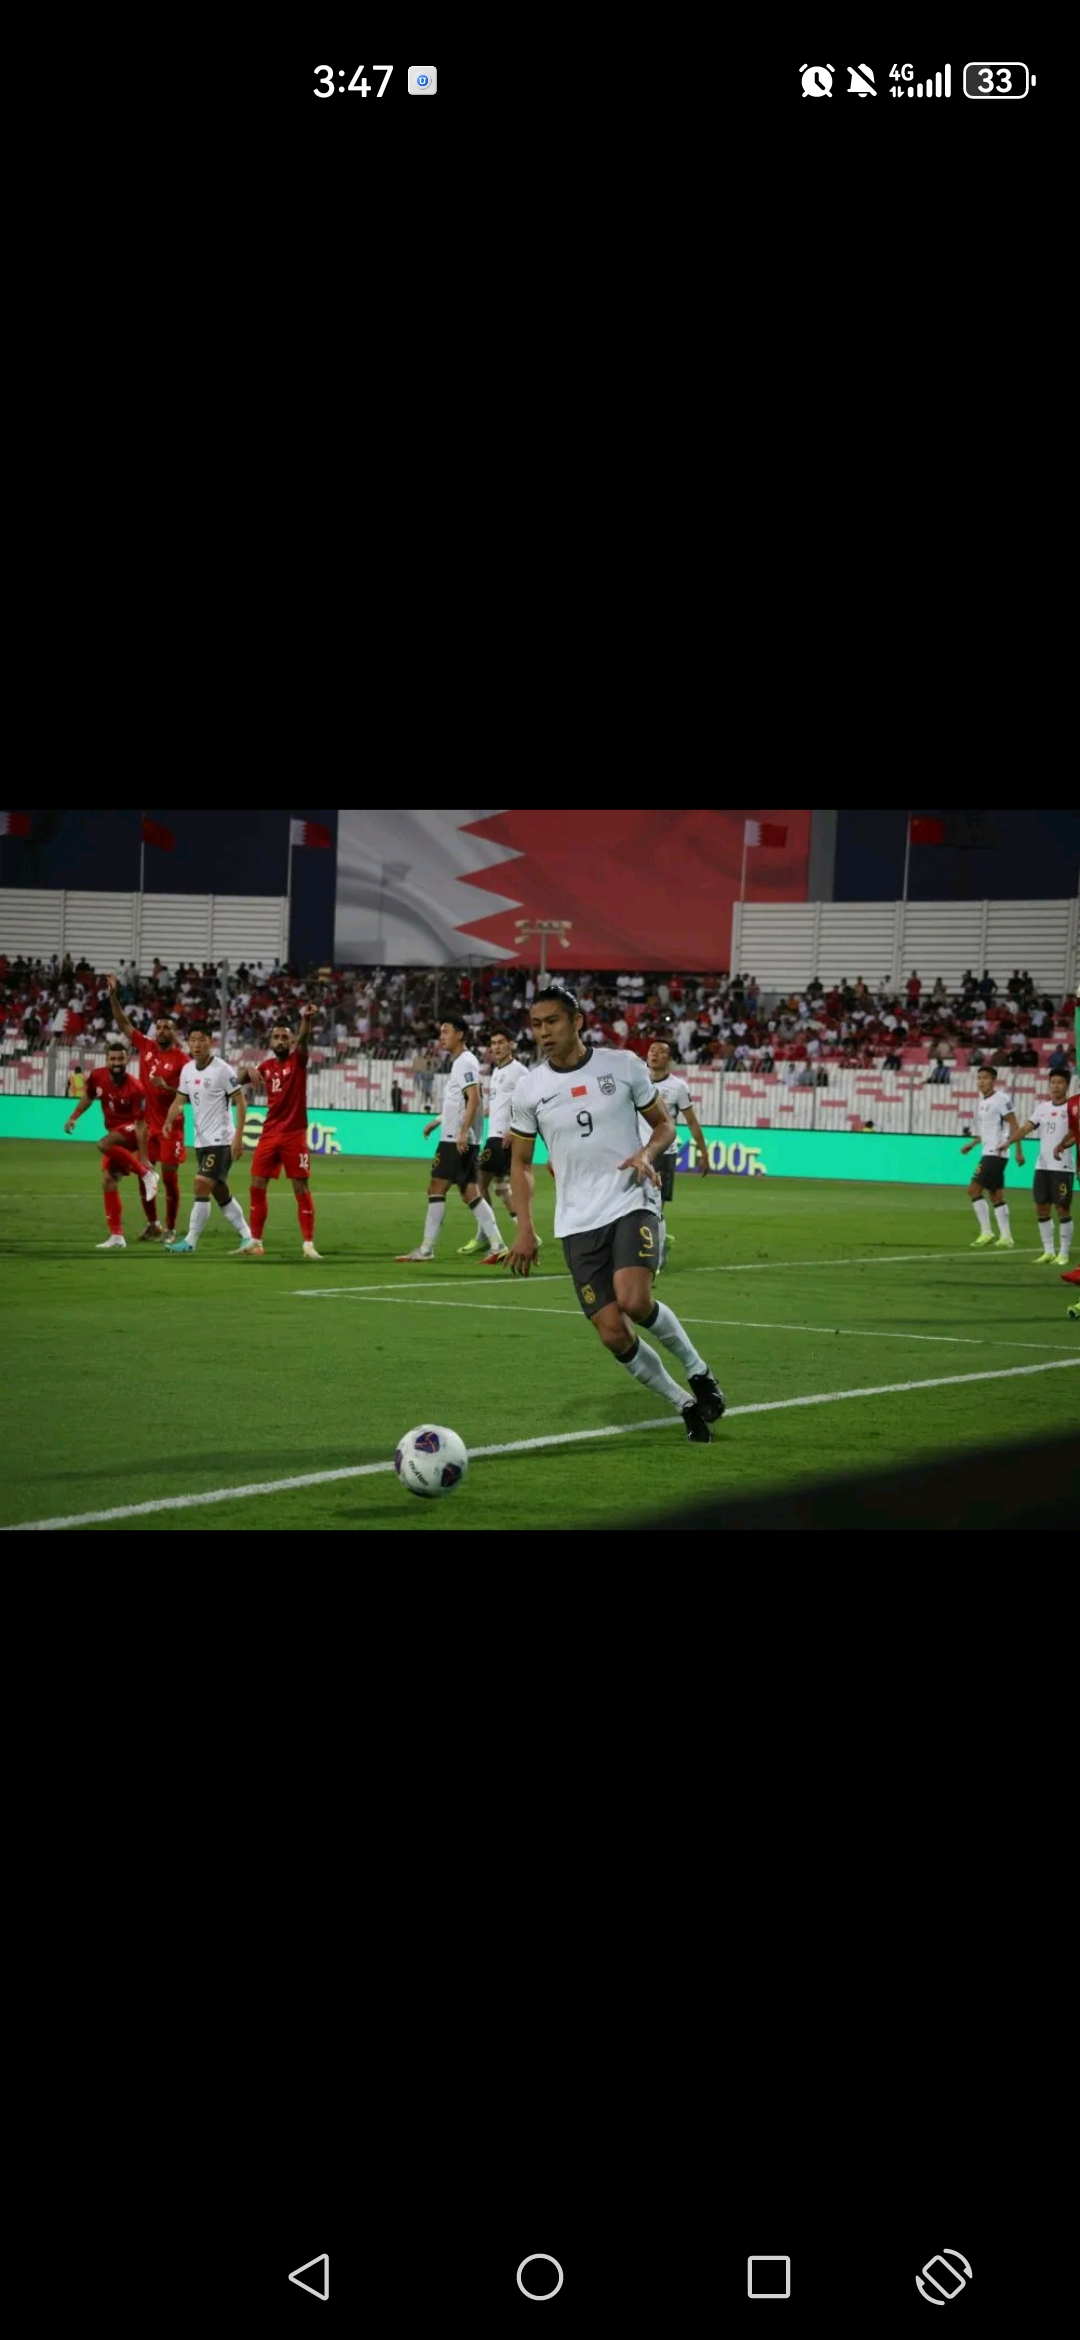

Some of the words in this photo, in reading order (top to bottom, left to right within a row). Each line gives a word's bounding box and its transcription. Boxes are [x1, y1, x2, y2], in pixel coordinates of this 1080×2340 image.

[272, 1078, 283, 1093] 12
[576, 1110, 594, 1138] 9
[1046, 1121, 1057, 1135] 19
[299, 1153, 309, 1168] 12
[640, 1225, 654, 1249] 9
